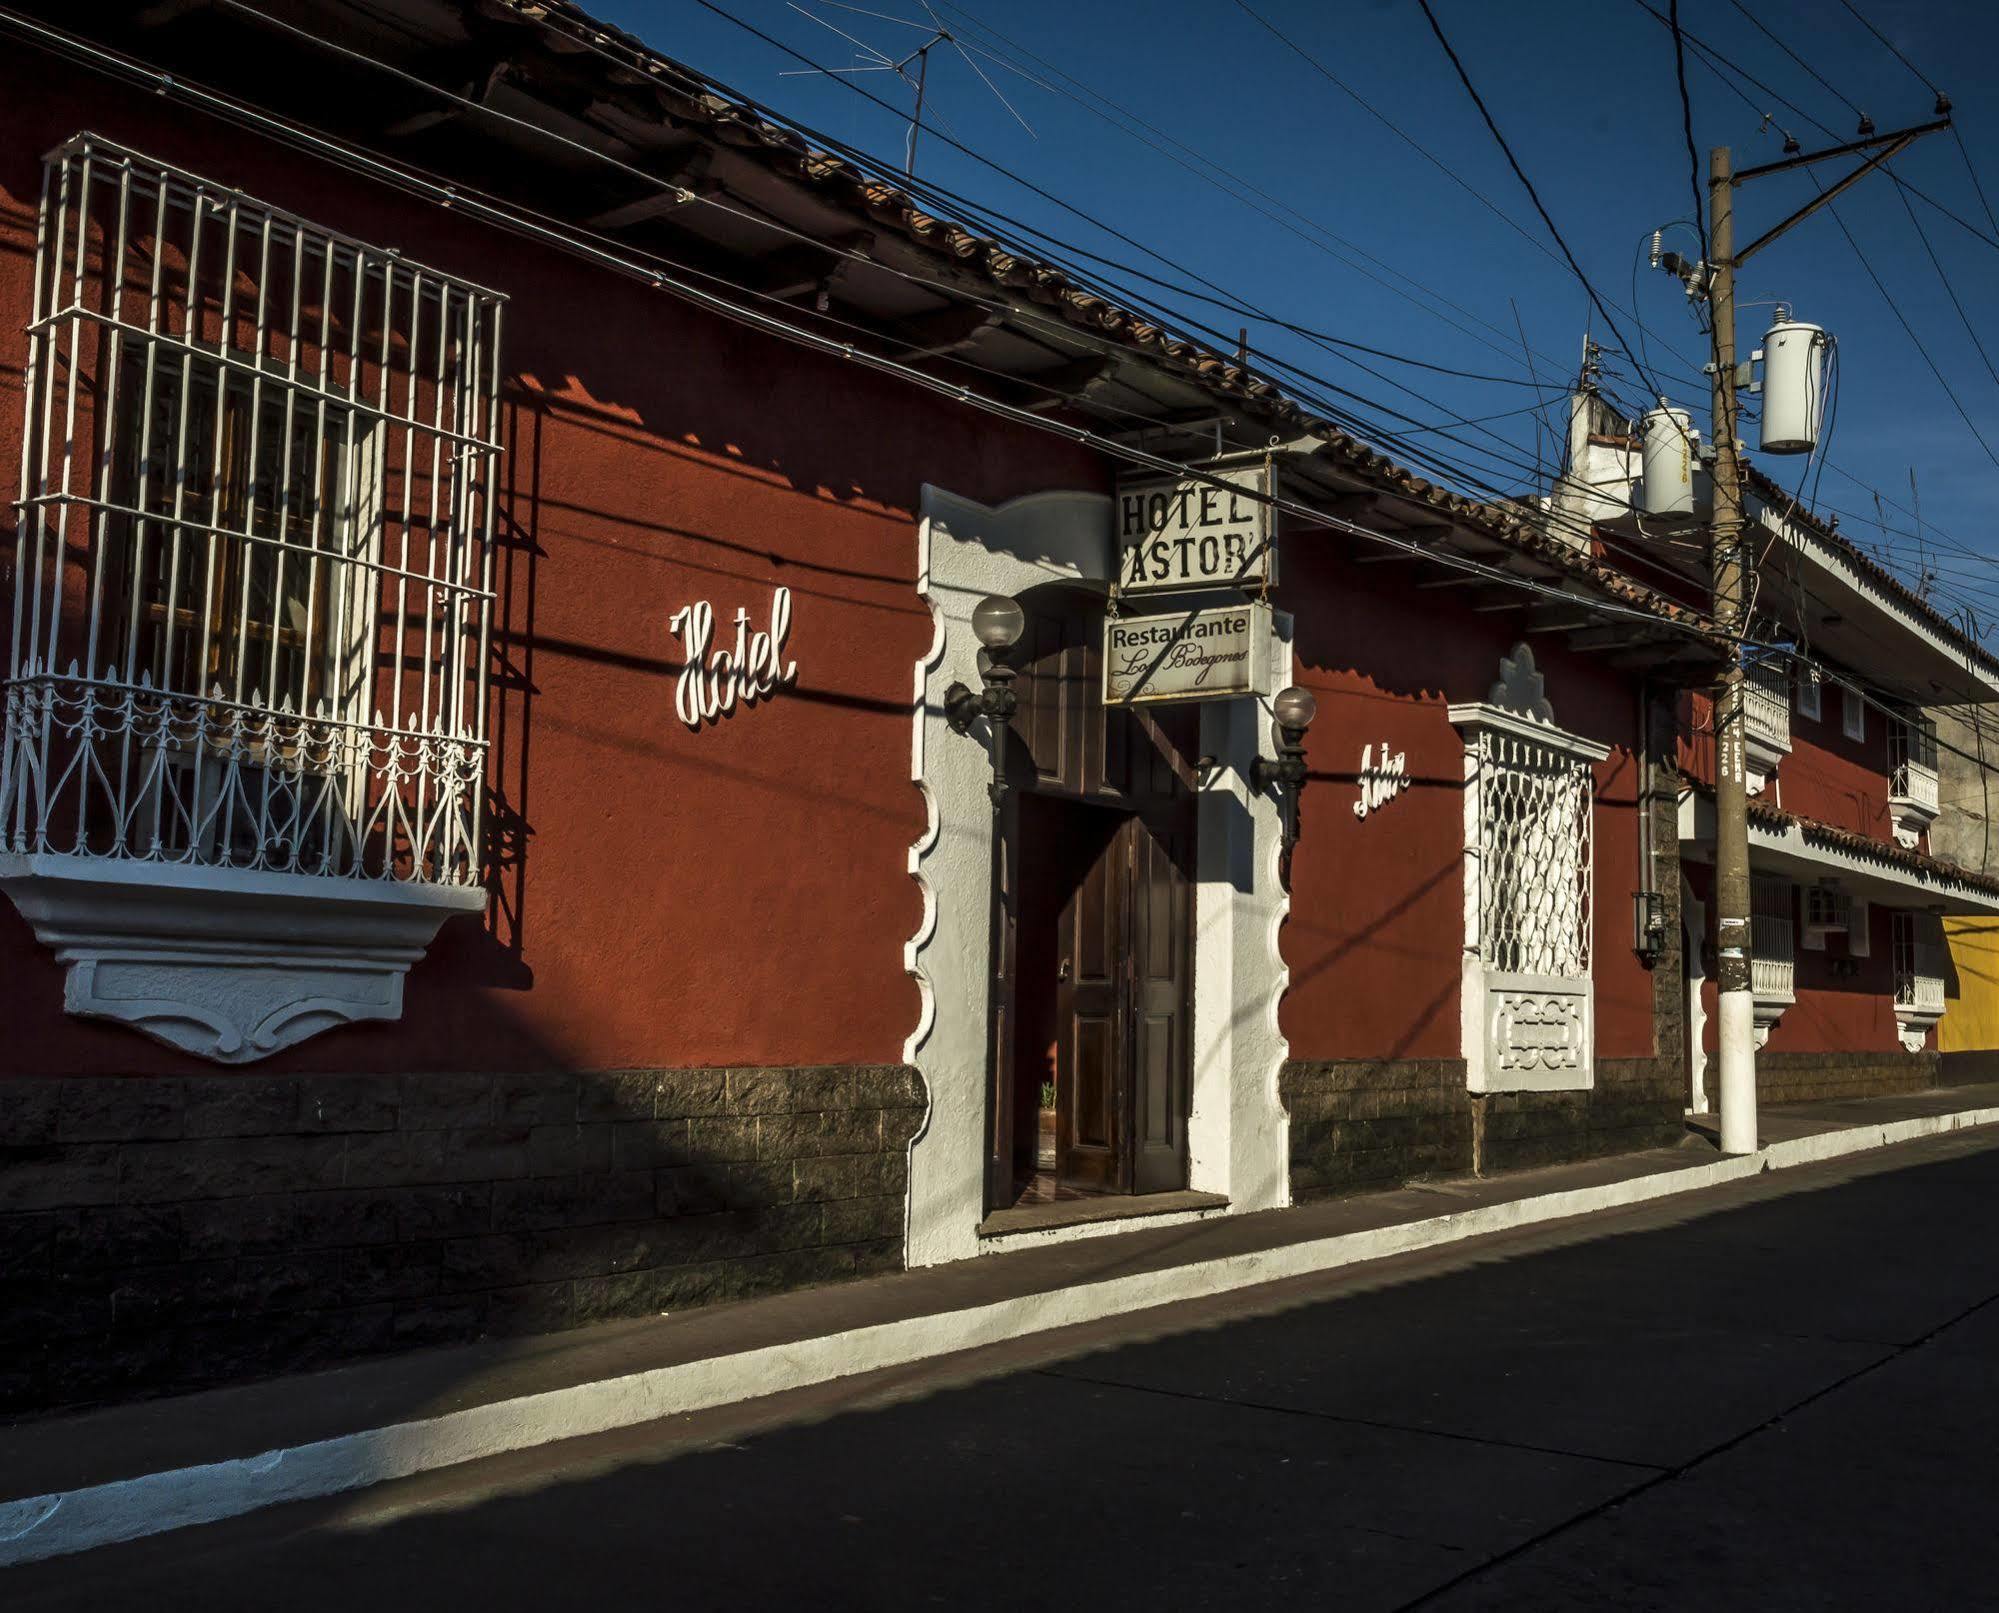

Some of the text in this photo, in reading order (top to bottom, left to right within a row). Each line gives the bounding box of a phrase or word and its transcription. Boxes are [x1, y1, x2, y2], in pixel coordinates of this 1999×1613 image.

[1122, 484, 1253, 535] HOTEL
[669, 587, 797, 725] Hotel
[1113, 616, 1247, 649] Restaurante
[1163, 643, 1250, 686] Bodegones
